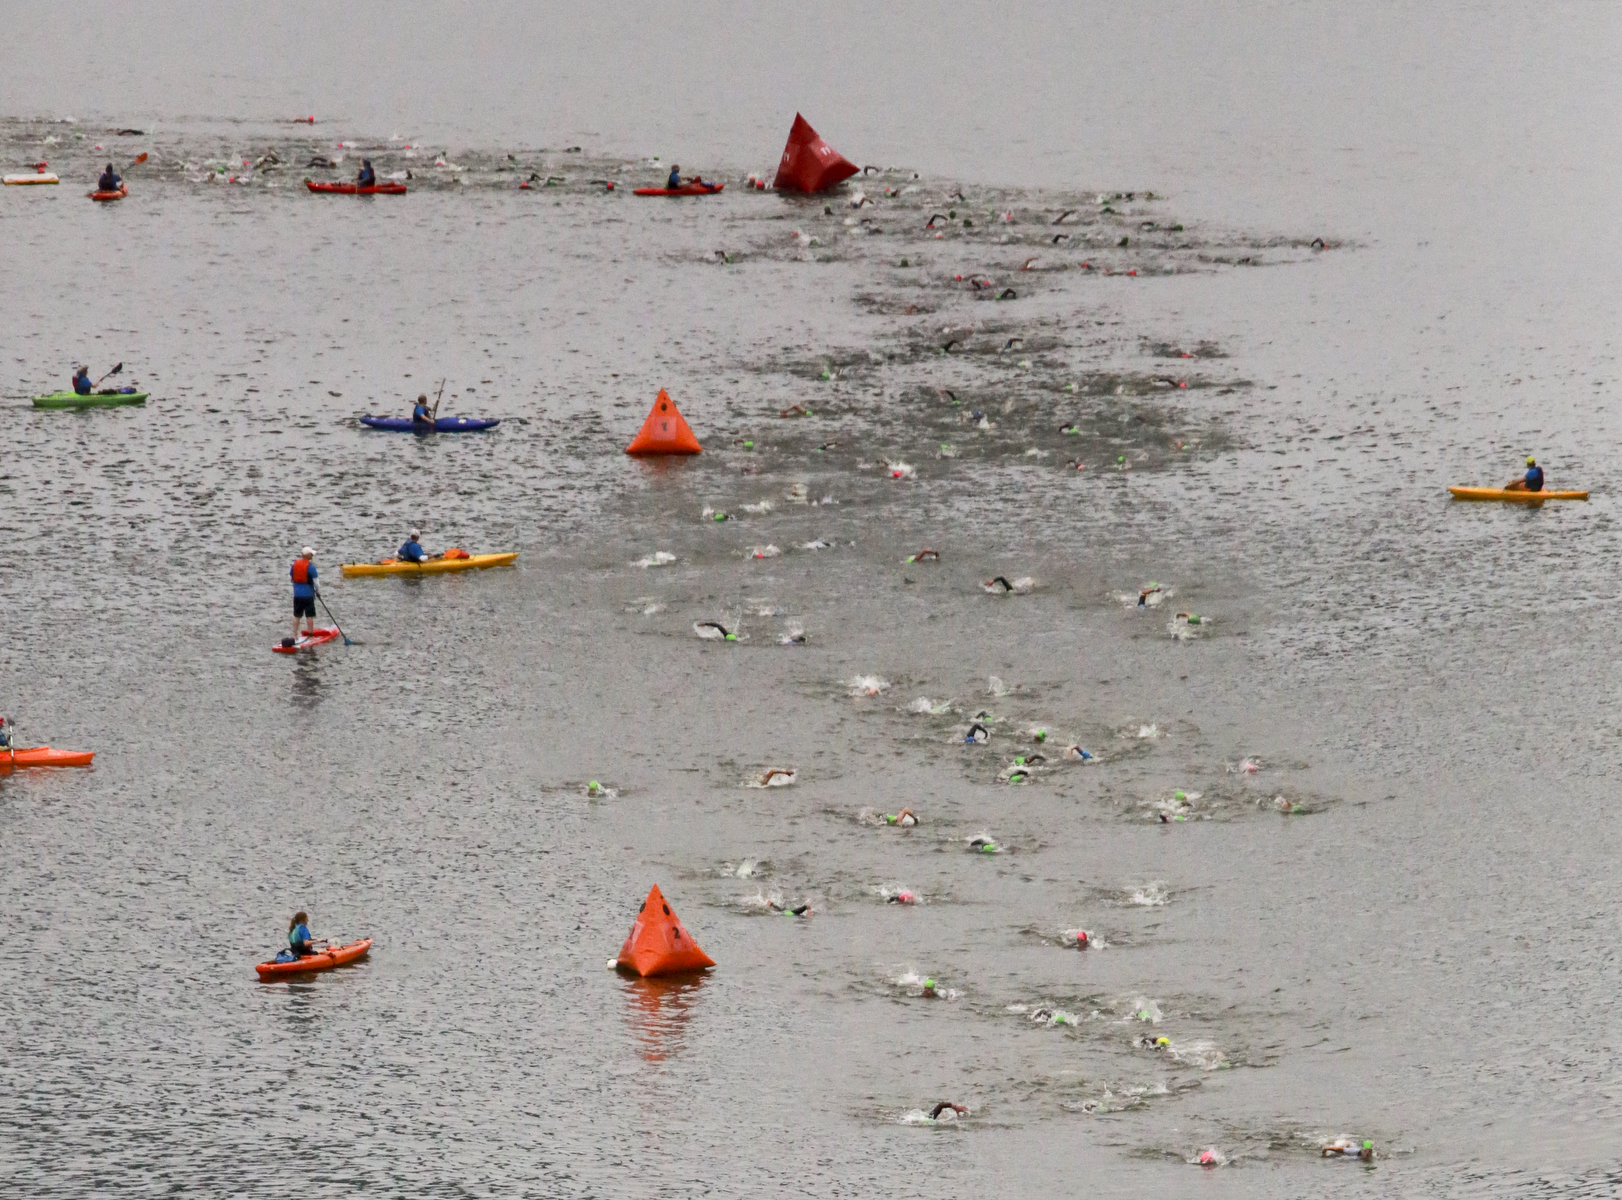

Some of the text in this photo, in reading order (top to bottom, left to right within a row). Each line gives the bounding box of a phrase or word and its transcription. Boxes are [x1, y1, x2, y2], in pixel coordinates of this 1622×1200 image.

[820, 146, 831, 156] T1
[661, 422, 667, 431] 1
[672, 926, 680, 939] 2
